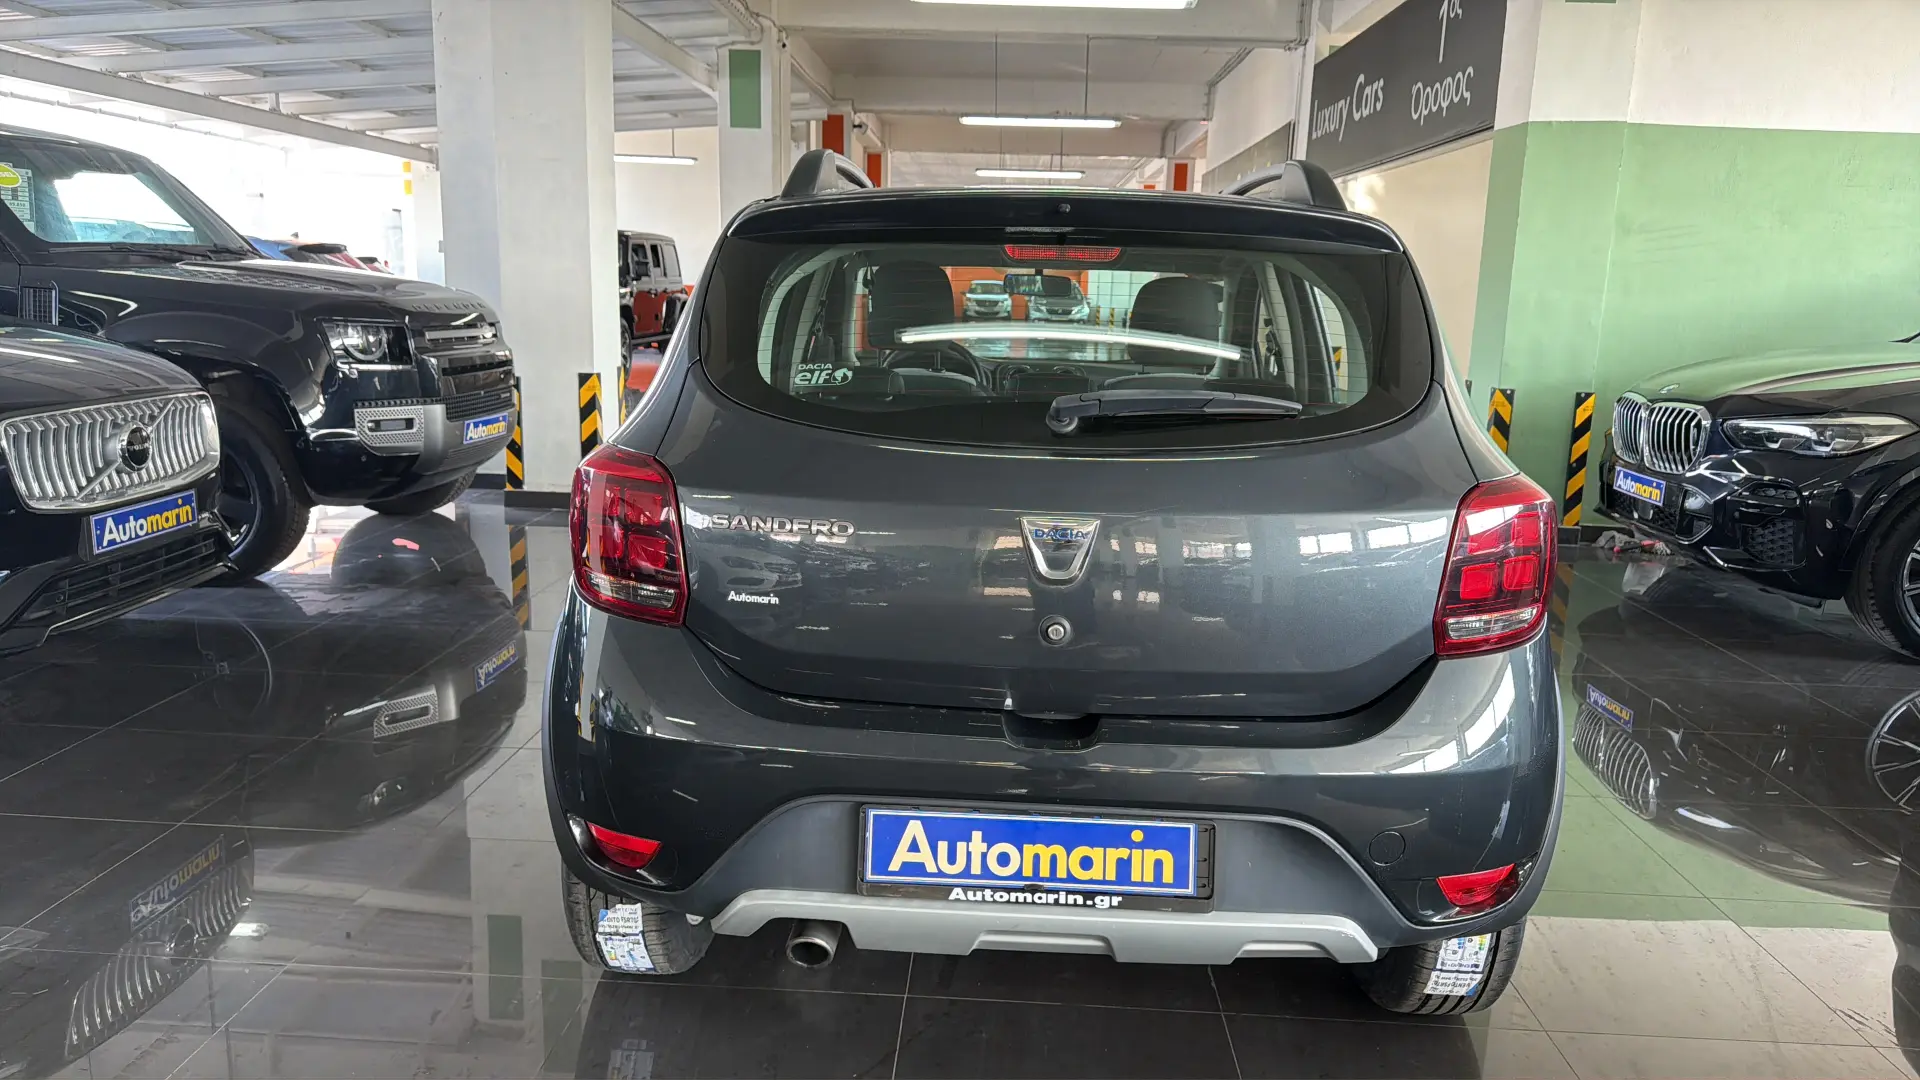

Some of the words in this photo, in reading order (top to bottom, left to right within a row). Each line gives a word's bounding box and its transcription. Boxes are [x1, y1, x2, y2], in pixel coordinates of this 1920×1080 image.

[1312, 96, 1350, 142] Luxury
[1352, 74, 1385, 121] Cars
[1411, 66, 1474, 126] Όροφος
[794, 369, 833, 385] elf
[466, 416, 506, 441] Automarin
[1616, 471, 1661, 501] Automarin
[102, 498, 192, 547] Automarin
[711, 513, 855, 537] SANDERO
[1033, 528, 1086, 540] DACIA
[727, 590, 780, 605] Automarin
[888, 819, 1174, 884] Automarin
[948, 887, 1123, 909] Automarin.gr
